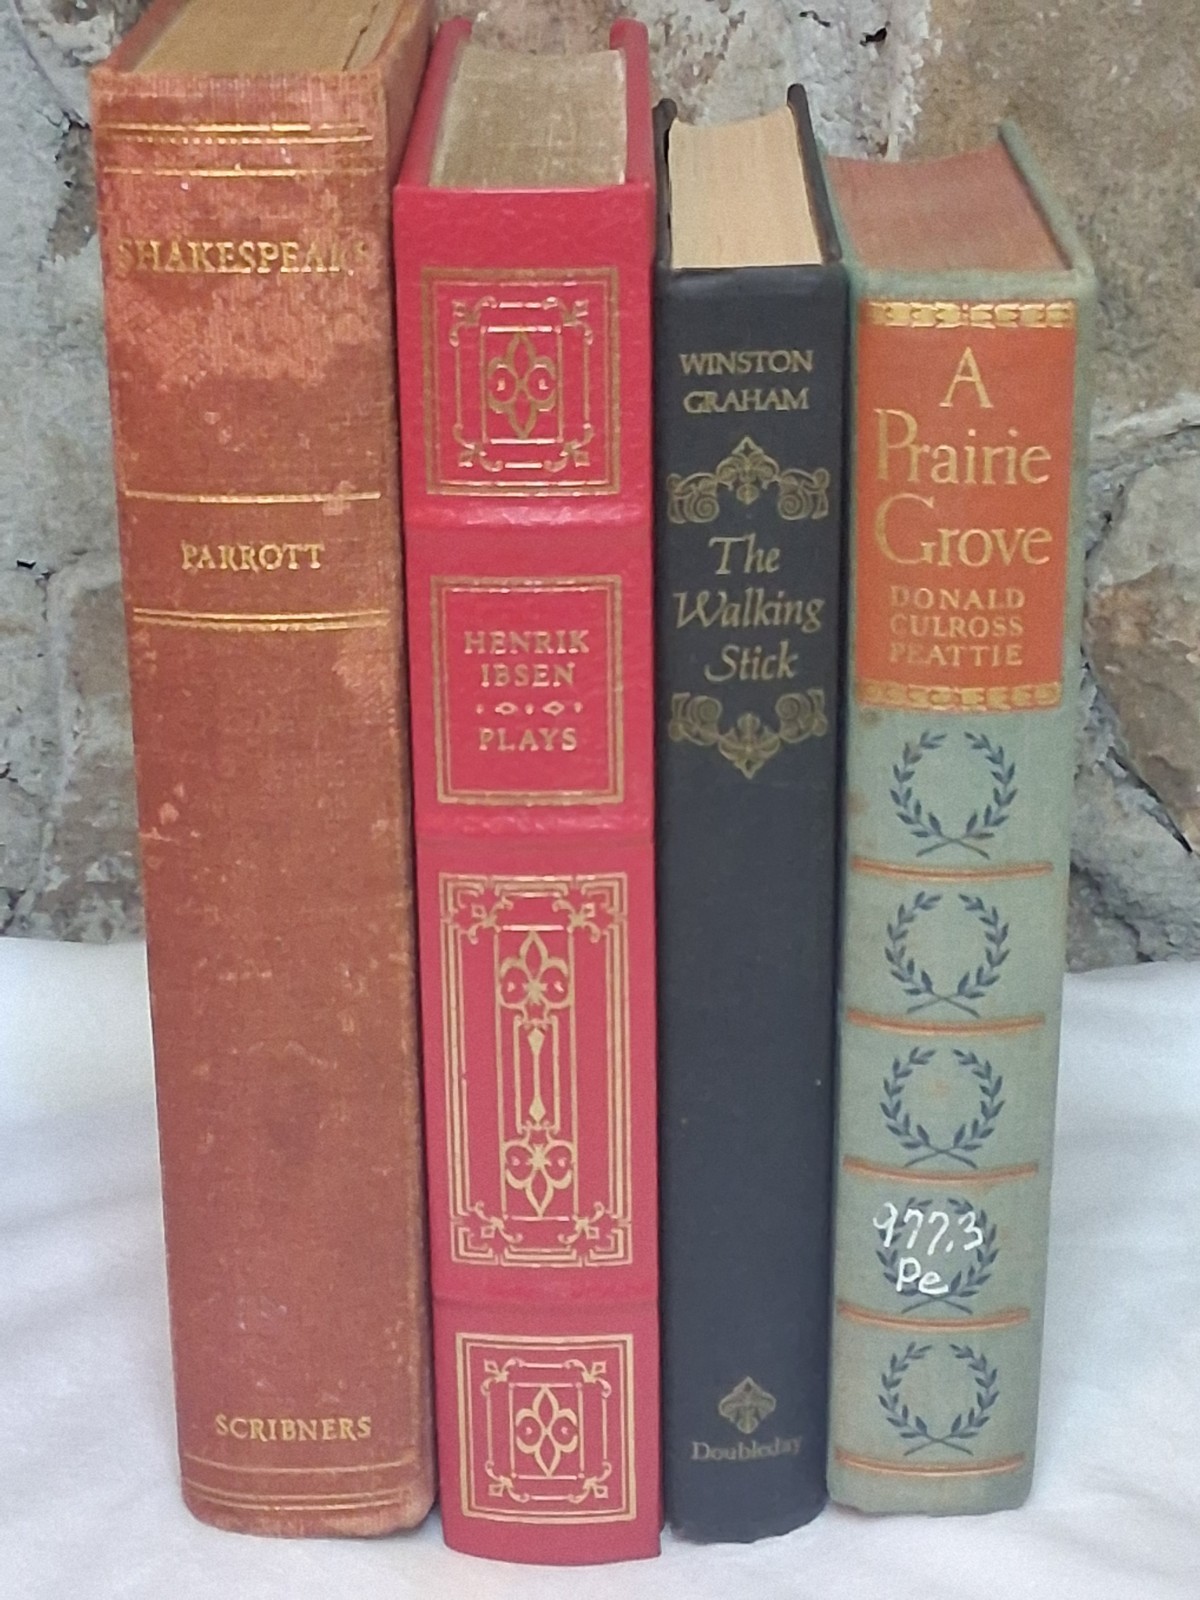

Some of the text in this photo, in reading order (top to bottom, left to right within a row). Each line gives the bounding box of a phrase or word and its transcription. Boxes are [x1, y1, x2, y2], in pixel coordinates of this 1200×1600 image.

[680, 350, 814, 376] WINSTON
[939, 346, 994, 408] A
[683, 388, 810, 413] GRAHAM
[874, 408, 1052, 485] Prairie
[874, 493, 1053, 567] Grove
[181, 541, 324, 571] PARROTT
[708, 533, 780, 575] The
[673, 586, 825, 633] Walking
[889, 585, 1026, 611] DONALD
[890, 614, 1024, 639] CULROSS
[464, 629, 590, 655] HENRIK
[889, 642, 1023, 668] PEATTIE
[480, 661, 576, 688] IBSEN
[704, 640, 799, 682] Stick
[479, 727, 578, 752] PLAYS
[215, 1413, 372, 1442] SCRIBNERS
